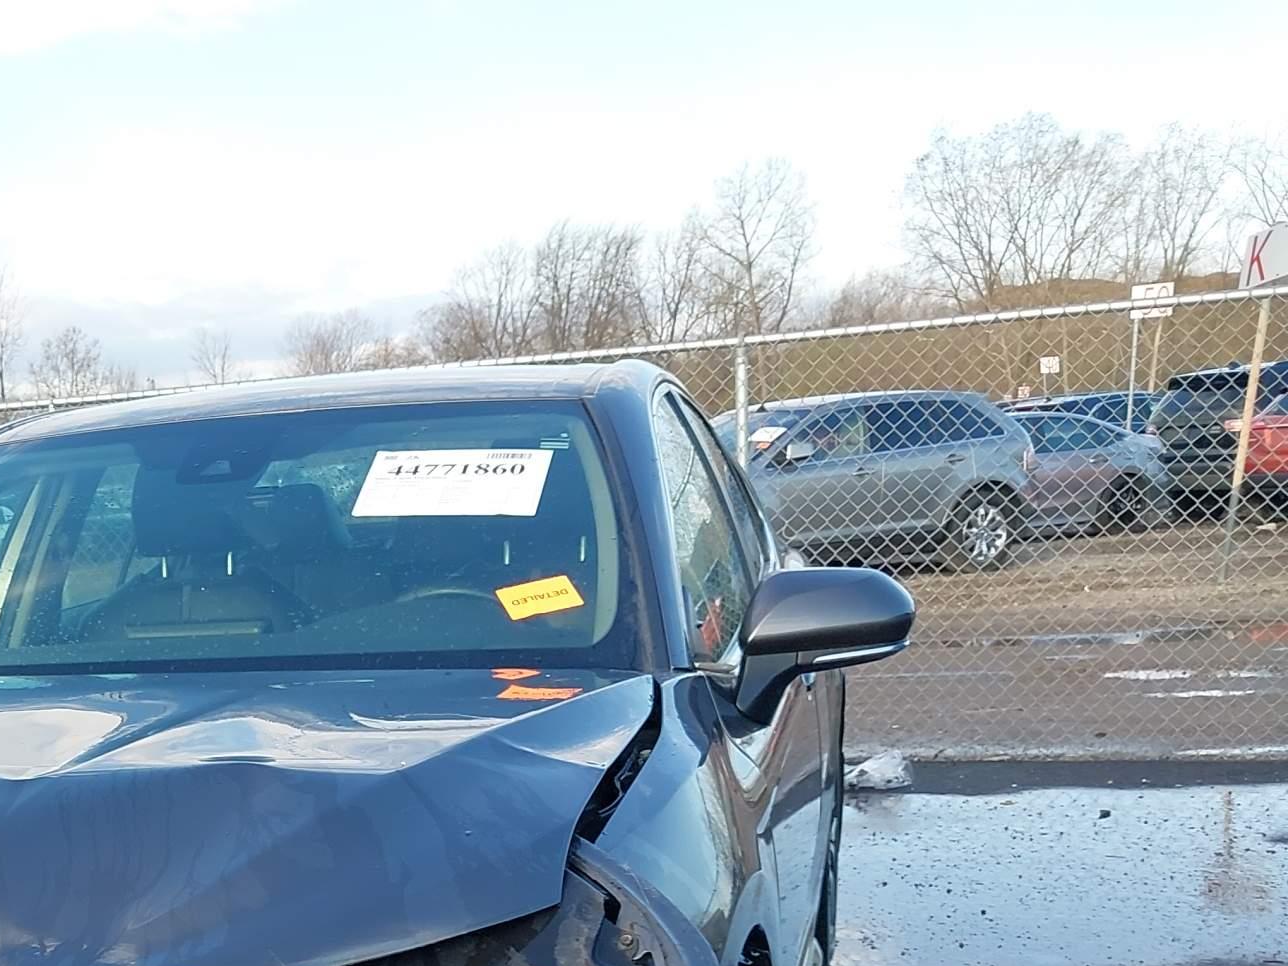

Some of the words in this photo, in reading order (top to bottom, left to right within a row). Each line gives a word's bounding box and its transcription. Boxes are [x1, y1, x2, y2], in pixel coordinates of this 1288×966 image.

[1246, 229, 1273, 287] K
[387, 463, 526, 476] 44771860
[511, 588, 569, 606] DETAILED
